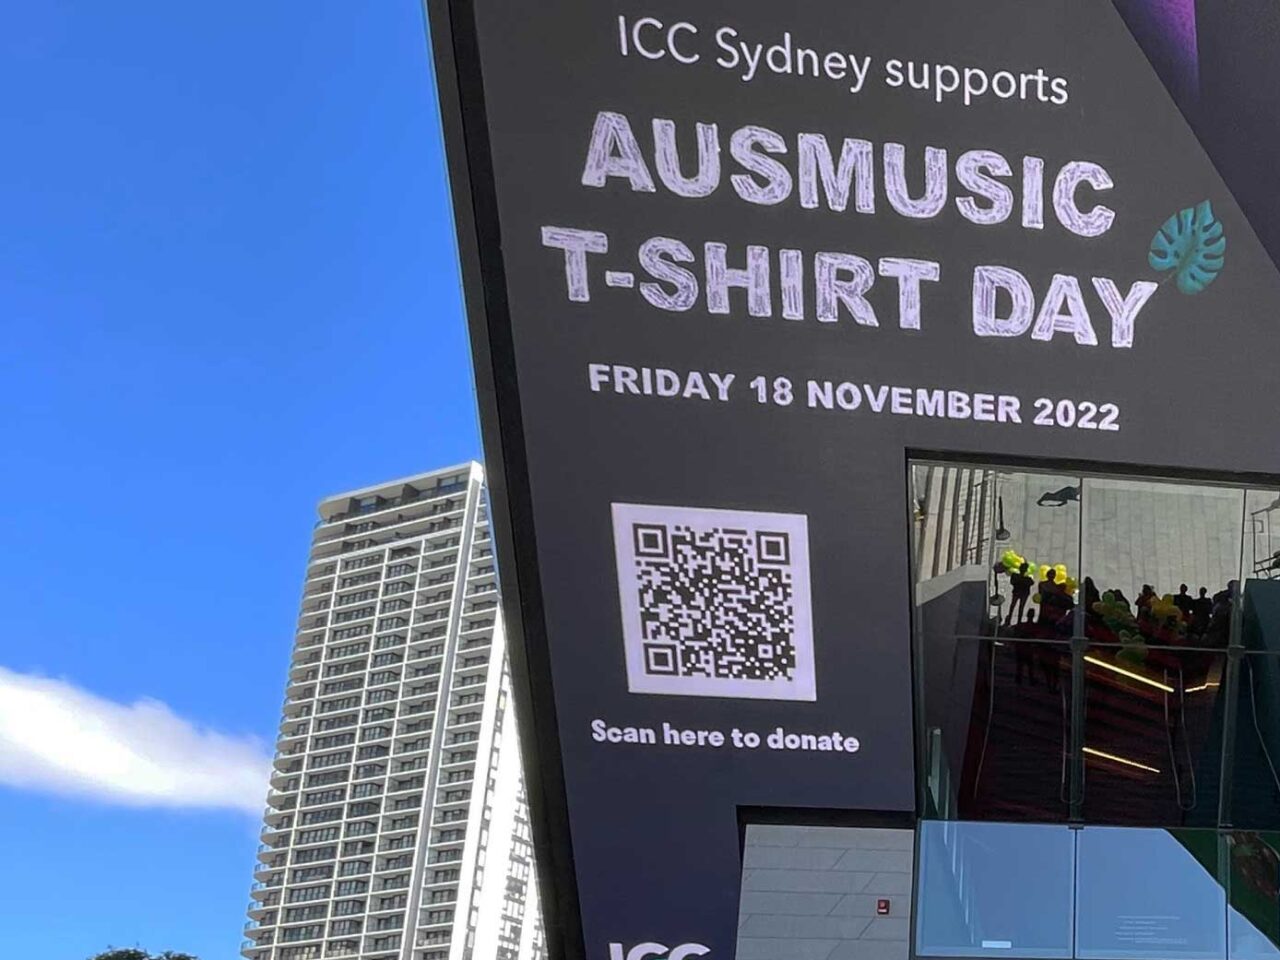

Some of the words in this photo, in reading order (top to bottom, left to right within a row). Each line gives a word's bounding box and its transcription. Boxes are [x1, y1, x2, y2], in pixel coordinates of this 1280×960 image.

[619, 16, 699, 64] ICC
[715, 27, 872, 93] Sydney
[885, 59, 1069, 105] supports
[581, 111, 1116, 238] AUSMUSIC
[541, 225, 941, 330] T-SHIRT
[972, 265, 1159, 348] DAY
[588, 363, 736, 403] FRIDAY
[749, 375, 794, 405] 18
[806, 380, 1023, 424] NOVEMBER
[1032, 397, 1120, 432] 2022
[591, 719, 656, 744] Scan
[662, 722, 725, 747] here
[730, 728, 761, 748] to
[766, 727, 860, 753] donate
